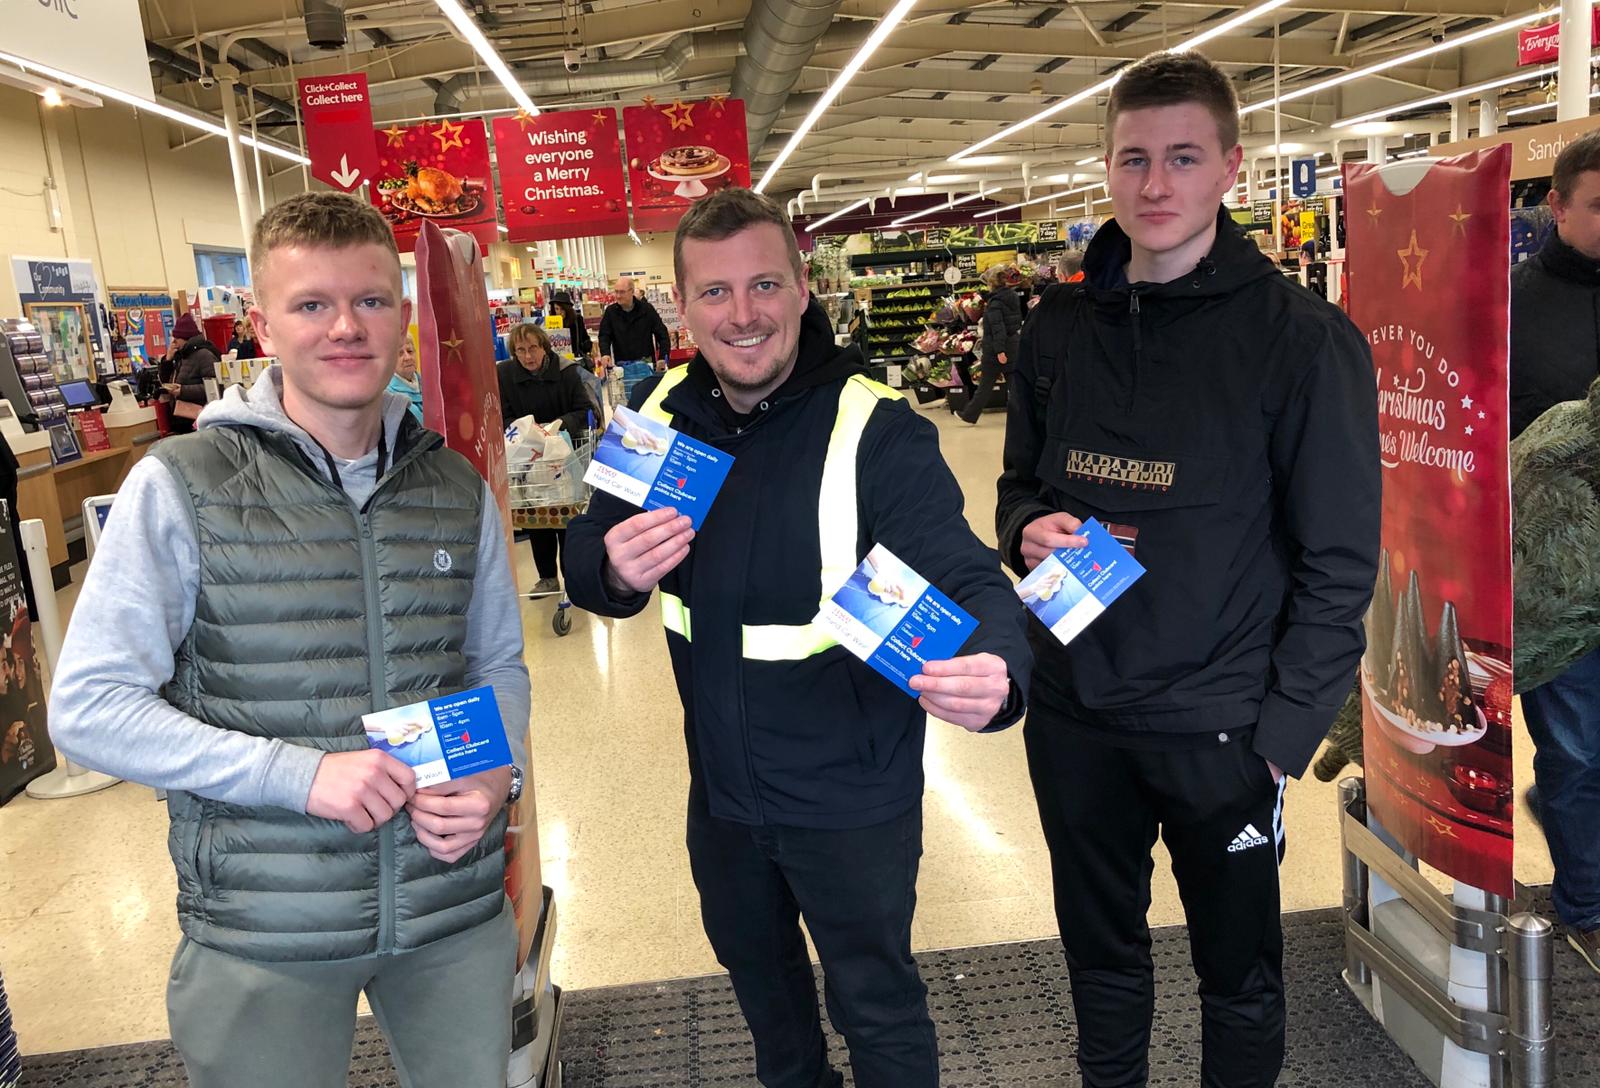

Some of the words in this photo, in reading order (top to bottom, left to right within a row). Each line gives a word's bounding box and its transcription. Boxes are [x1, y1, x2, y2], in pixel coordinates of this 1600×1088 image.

[304, 82, 358, 93] Click+Collect
[307, 95, 340, 106] Collect
[341, 93, 363, 103] here
[527, 129, 587, 146] Wishing
[525, 149, 594, 165] everyone
[533, 172, 543, 182] a
[546, 167, 590, 182] Merry
[524, 184, 604, 201] Christmas.
[1410, 329, 1435, 359] YOU
[1438, 357, 1459, 387] DO
[694, 449, 706, 458] open
[706, 454, 718, 463] daily
[1400, 430, 1475, 482] Welcome
[655, 486, 669, 496] points
[670, 493, 681, 501] here
[657, 480, 674, 491] Collect
[675, 488, 696, 502] Clubcard
[939, 607, 952, 618] open
[950, 614, 962, 626] daily
[886, 641, 900, 654] points
[900, 651, 911, 661] here
[890, 635, 907, 649] Collect
[906, 647, 926, 664] Clubcard
[468, 696, 480, 704] daily
[446, 746, 464, 754] Collect
[466, 739, 489, 748] Clubcard
[1227, 836, 1269, 852] adidas
